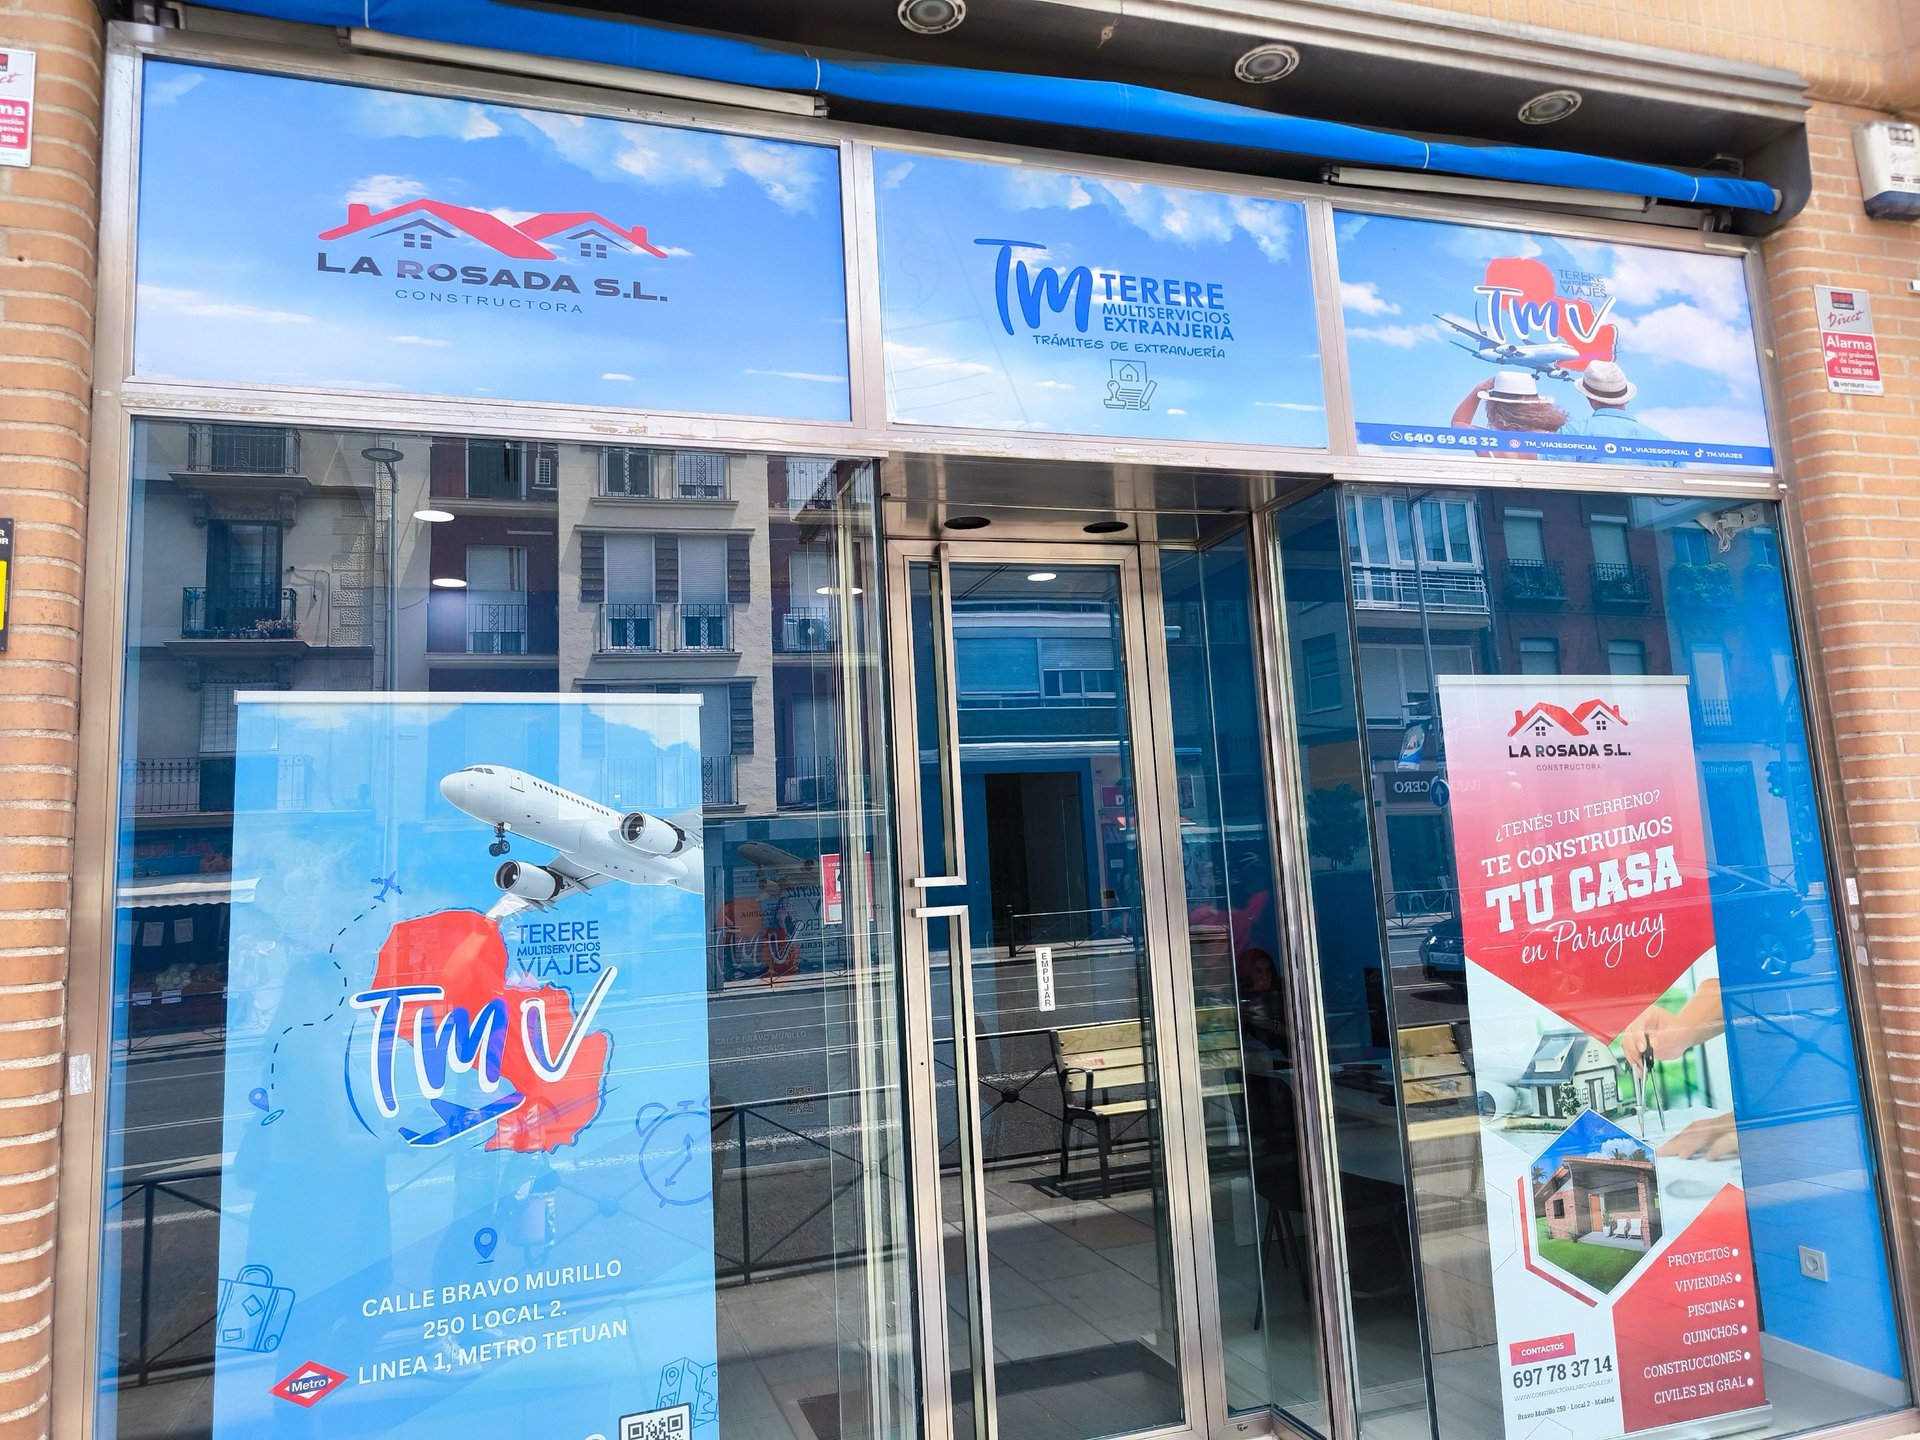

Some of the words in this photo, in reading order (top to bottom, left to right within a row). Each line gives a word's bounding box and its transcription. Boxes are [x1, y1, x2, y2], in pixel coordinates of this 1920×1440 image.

[318, 252, 383, 276] LA
[397, 259, 581, 293] ROSADA
[593, 278, 668, 302] S.L.
[1558, 269, 1604, 283] TERERE
[395, 289, 583, 314] CONSTRUCTORA
[1100, 273, 1225, 310] TERERE
[1561, 284, 1607, 298] VIAJES
[1102, 302, 1231, 325] MULTISERVICIOS
[1827, 310, 1864, 328] Direct
[1104, 317, 1234, 341] EXTRANJERIA
[1033, 334, 1104, 349] TRÁMITES
[1110, 341, 1128, 351] DE
[1135, 343, 1225, 358] EXTRANJERÍA
[1826, 335, 1873, 351] Alarma
[1404, 432, 1434, 443] 640
[1437, 434, 1456, 445] 69
[1459, 435, 1478, 446] 48
[1480, 436, 1498, 447] 32
[1509, 745, 1531, 758] LA
[1535, 744, 1600, 757] ROSADA
[1604, 743, 1631, 756] S.L.
[1536, 763, 1602, 772] CONSTRUCTORA
[1495, 813, 1553, 842] ¿TENÉS
[1556, 808, 1580, 825] UN
[1583, 789, 1661, 819] TERRENO?
[1481, 854, 1511, 878] TE
[1517, 816, 1673, 868] CONSTRUIMOS
[1485, 875, 1555, 933] TU
[1569, 845, 1683, 913] CASA
[516, 920, 600, 945] TERERE
[1522, 944, 1549, 964] en
[1546, 913, 1666, 968] Paraguay
[516, 941, 601, 957] MULTISERVICIOS
[517, 952, 602, 977] VIAJES
[1041, 952, 1051, 1007] EMPUJAR
[1667, 1247, 1730, 1268] PROYECTOS
[362, 1289, 435, 1318] CALLE
[442, 1276, 519, 1305] BRAVO
[526, 1259, 622, 1290] MURILLO
[1674, 1272, 1733, 1293] VIVIENDAS
[1687, 1298, 1736, 1317] PISCINAS
[423, 1316, 465, 1340] 250
[472, 1304, 546, 1332] LOCAL
[550, 1300, 567, 1318] 2.
[1682, 1324, 1739, 1345] QUINCHOS
[358, 1357, 428, 1385] LINEA
[434, 1352, 452, 1372] 1,
[458, 1337, 536, 1366] METRO
[543, 1320, 628, 1350] TETUAN
[1521, 1342, 1564, 1356] CONTACTOS
[1513, 1368, 1542, 1388] 697
[1546, 1364, 1567, 1382] 78
[1570, 1359, 1590, 1378] 37
[1594, 1355, 1612, 1374] 14
[1643, 1350, 1742, 1379] CONSTRUCCIONES
[291, 1378, 326, 1394] Metro
[1654, 1386, 1697, 1404] CIVILES
[1699, 1383, 1714, 1396] EN
[1715, 1377, 1745, 1393] GRAL
[1517, 1411, 1534, 1420] Bravo
[1535, 1407, 1556, 1417] Murillo
[1556, 1405, 1566, 1413] 250
[1570, 1400, 1586, 1410] Local
[1594, 1396, 1615, 1405] Madrid
